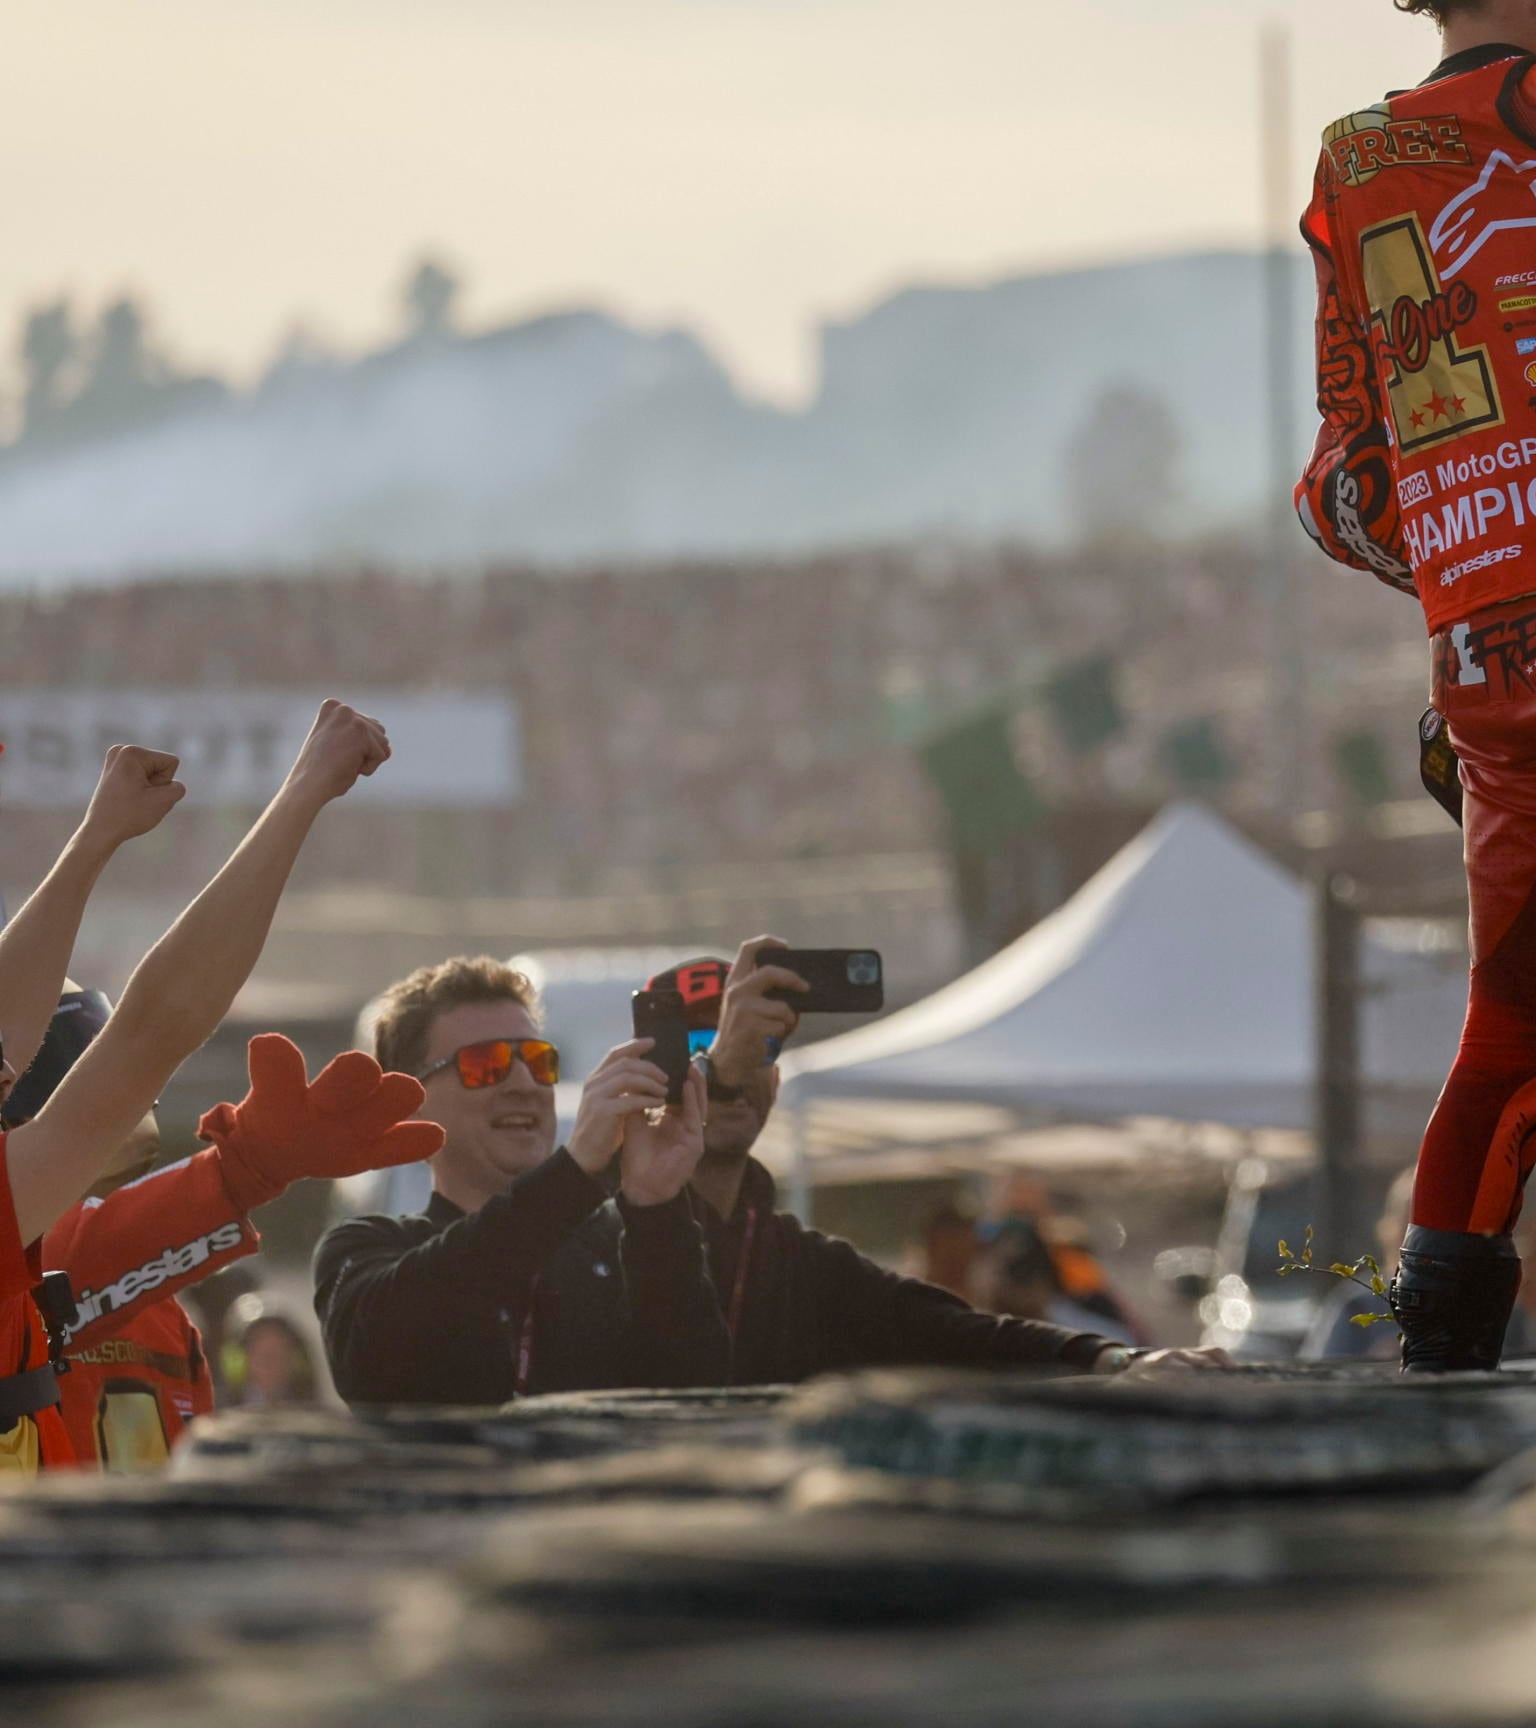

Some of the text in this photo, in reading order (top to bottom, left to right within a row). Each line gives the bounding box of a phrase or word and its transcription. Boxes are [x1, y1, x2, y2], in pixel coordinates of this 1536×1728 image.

[1399, 473, 1430, 506] 2023
[1440, 544, 1523, 587] alpinestars
[63, 1222, 242, 1346] pinestars
